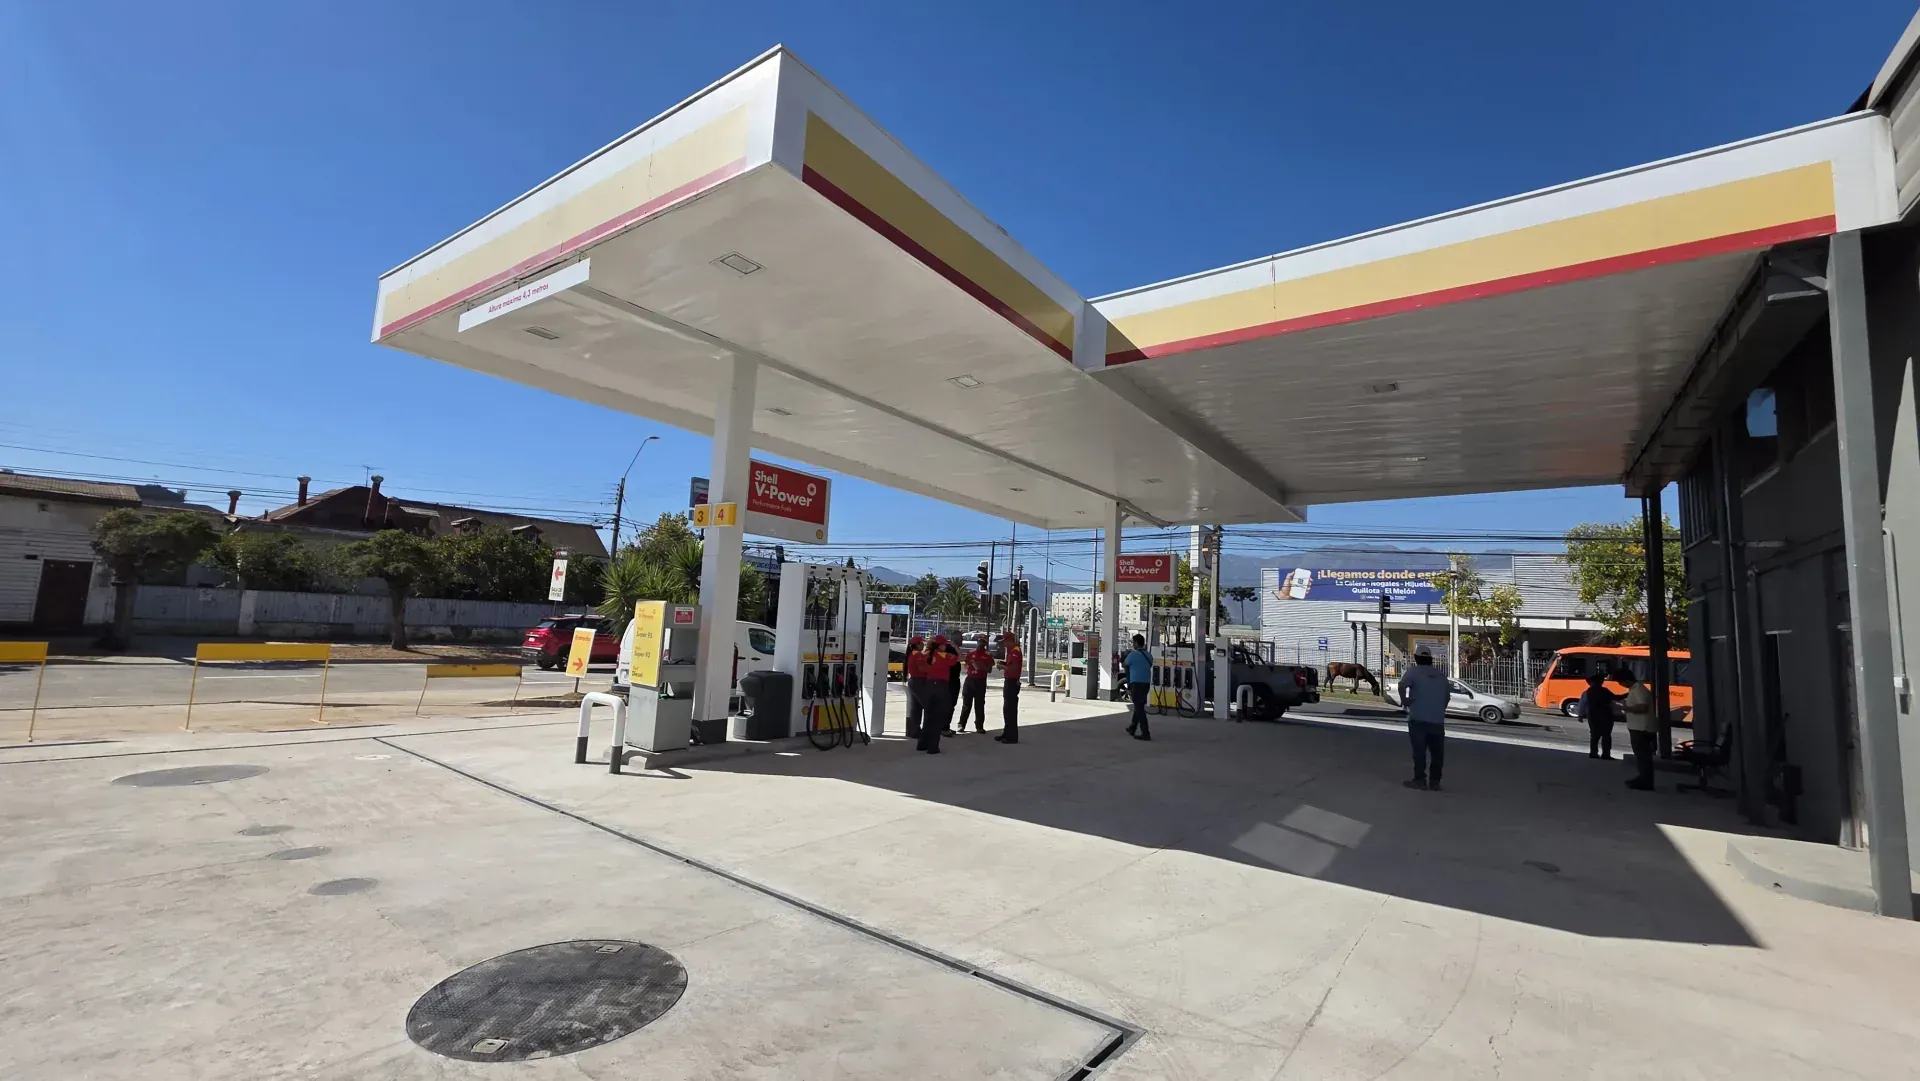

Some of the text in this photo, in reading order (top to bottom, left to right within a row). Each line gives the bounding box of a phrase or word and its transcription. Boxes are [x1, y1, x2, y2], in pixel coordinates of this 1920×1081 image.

[488, 304, 502, 313] Altura
[502, 295, 522, 307] máxima
[532, 284, 549, 295] metros
[755, 470, 778, 485] Shell
[755, 482, 813, 507] V-Power
[752, 499, 792, 512] Performance Fuels
[697, 510, 704, 522] 3
[718, 508, 724, 520] 4
[1119, 566, 1160, 574] V-Power
[1377, 570, 1416, 579] donde
